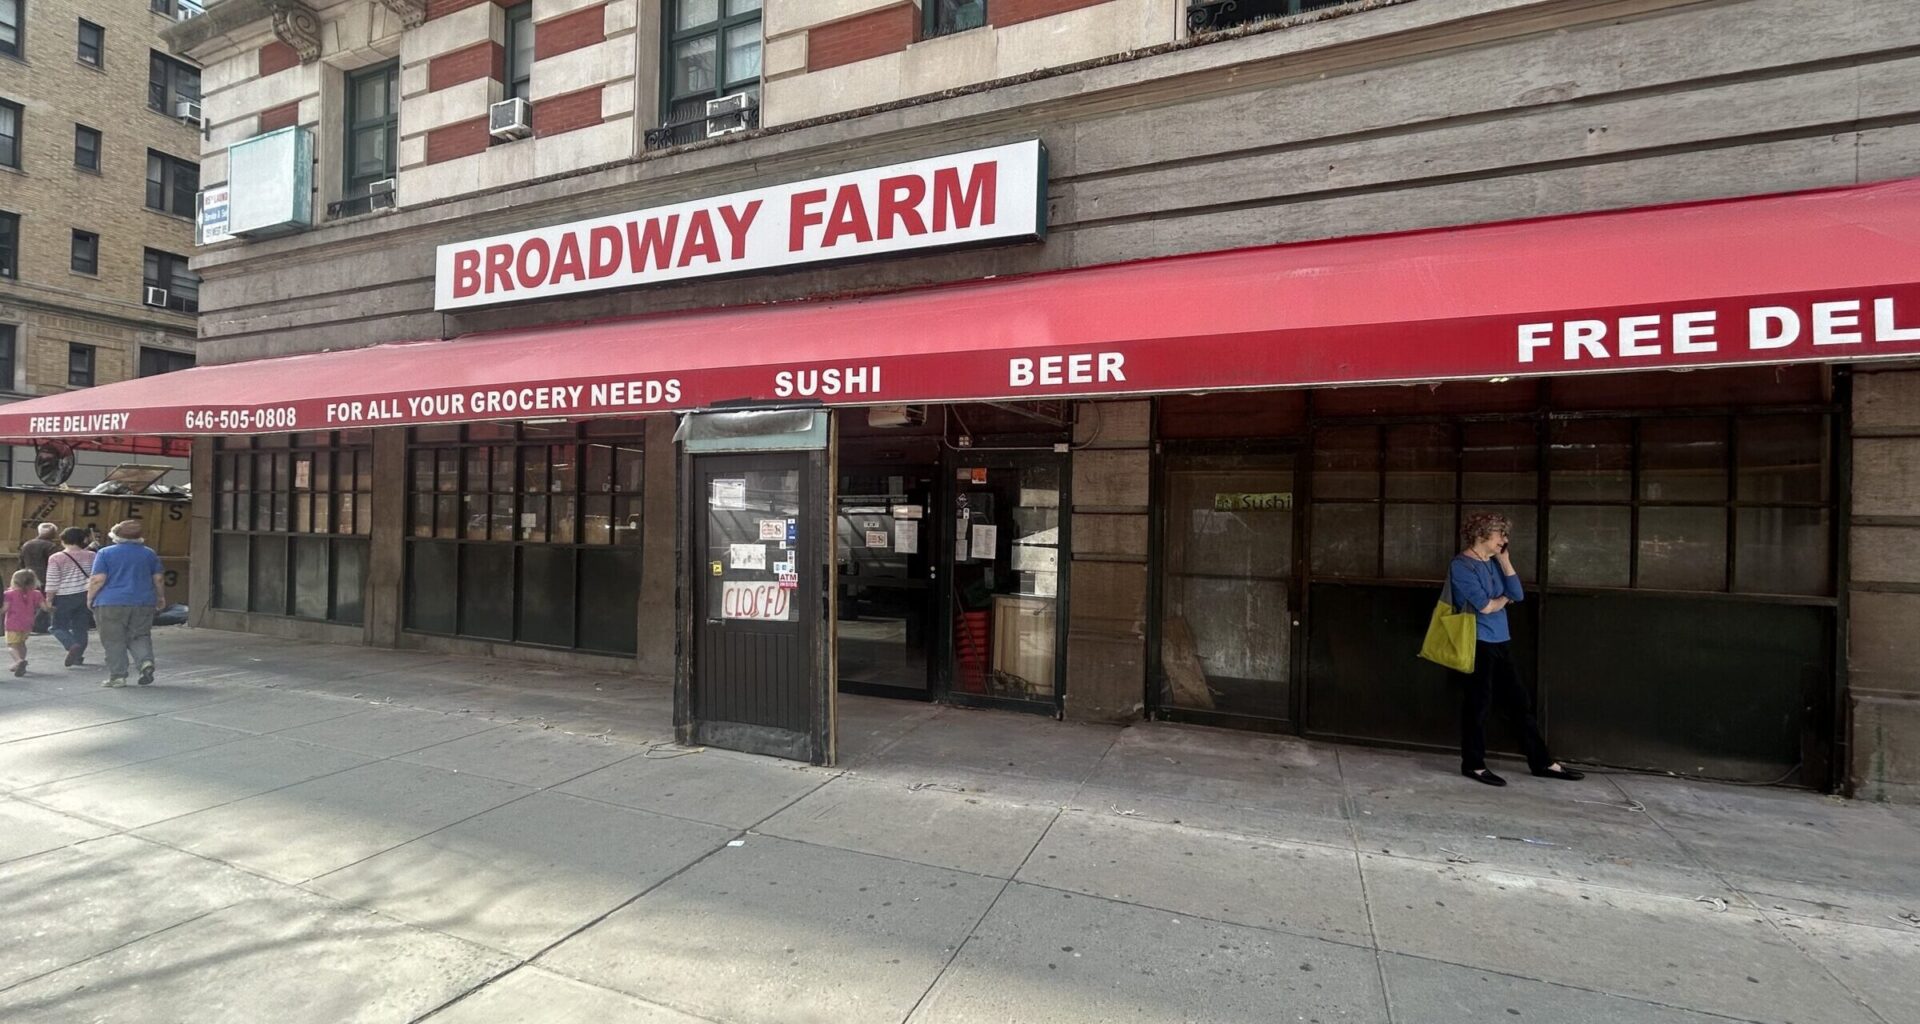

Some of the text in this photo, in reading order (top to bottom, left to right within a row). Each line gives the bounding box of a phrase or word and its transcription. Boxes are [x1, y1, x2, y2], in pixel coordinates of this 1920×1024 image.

[453, 161, 998, 298] BROADWAY FARM
[1517, 297, 1920, 363] FREE DEL
[774, 366, 882, 397] SUSHI
[1009, 352, 1126, 387] BEER
[326, 378, 683, 423] FOR ALL YOUR GROCERY NEEDS
[29, 411, 130, 434] FREE DELIVERY
[185, 406, 298, 430] 646-505-0808
[1242, 495, 1292, 510] Sushi
[780, 573, 797, 581] ATM
[725, 585, 787, 618] CLOSED
